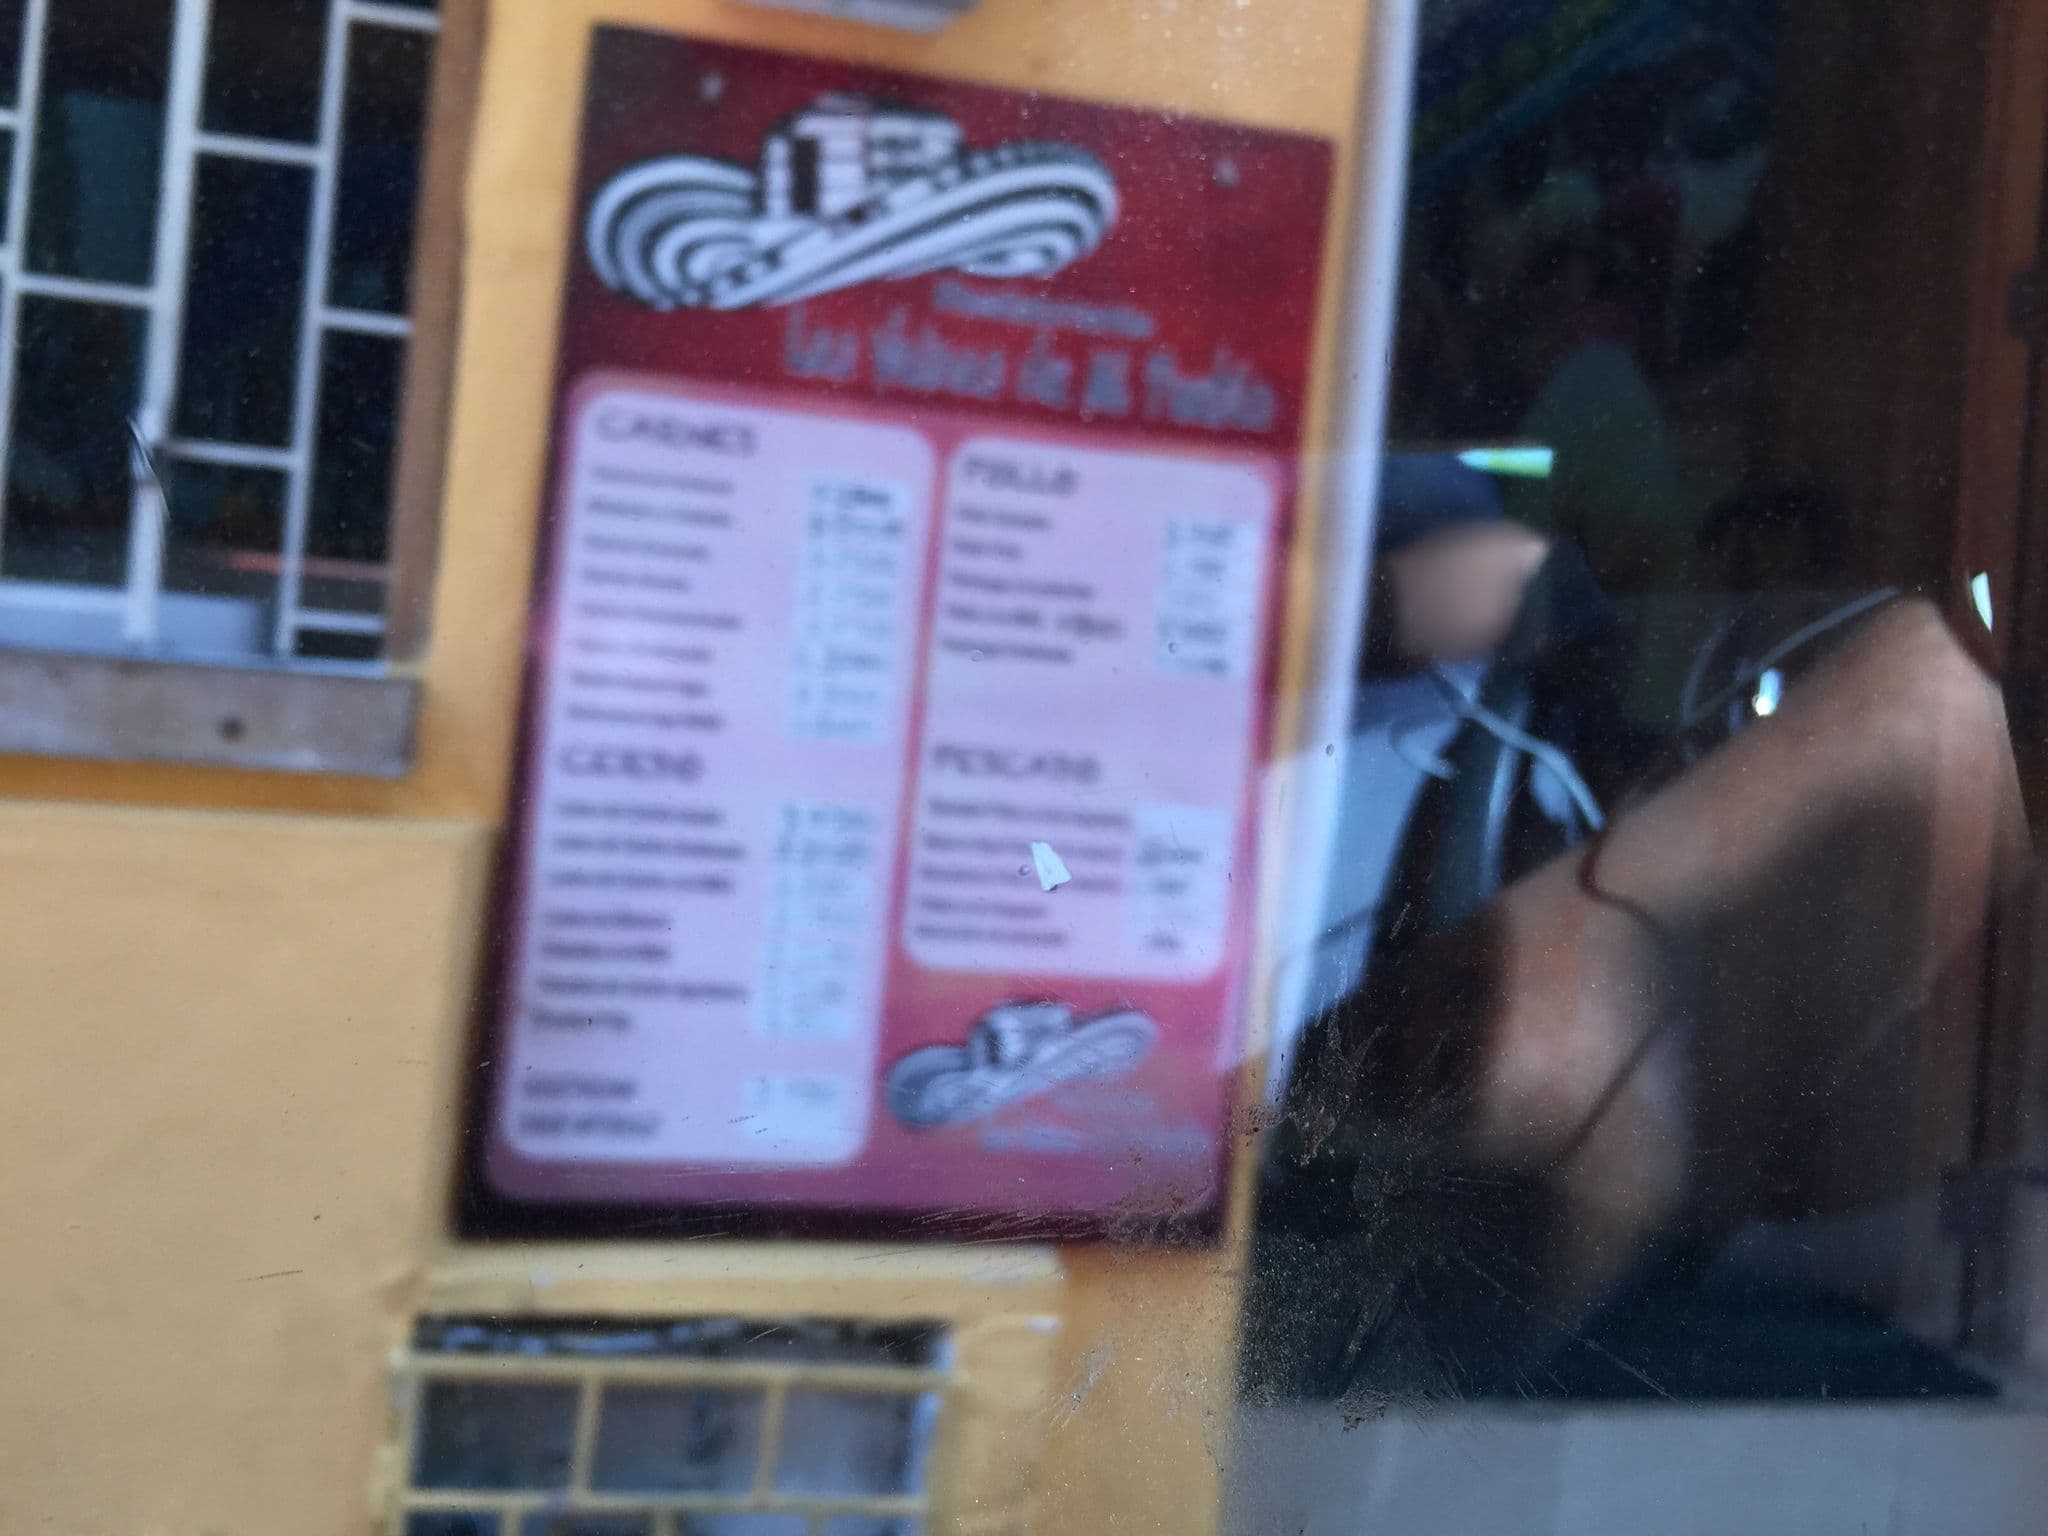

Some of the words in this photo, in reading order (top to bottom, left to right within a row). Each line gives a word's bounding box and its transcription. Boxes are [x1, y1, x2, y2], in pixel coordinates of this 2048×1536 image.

[597, 406, 758, 458] CARNES
[963, 456, 1078, 496] POLLO
[931, 746, 1101, 784] PESCADO
